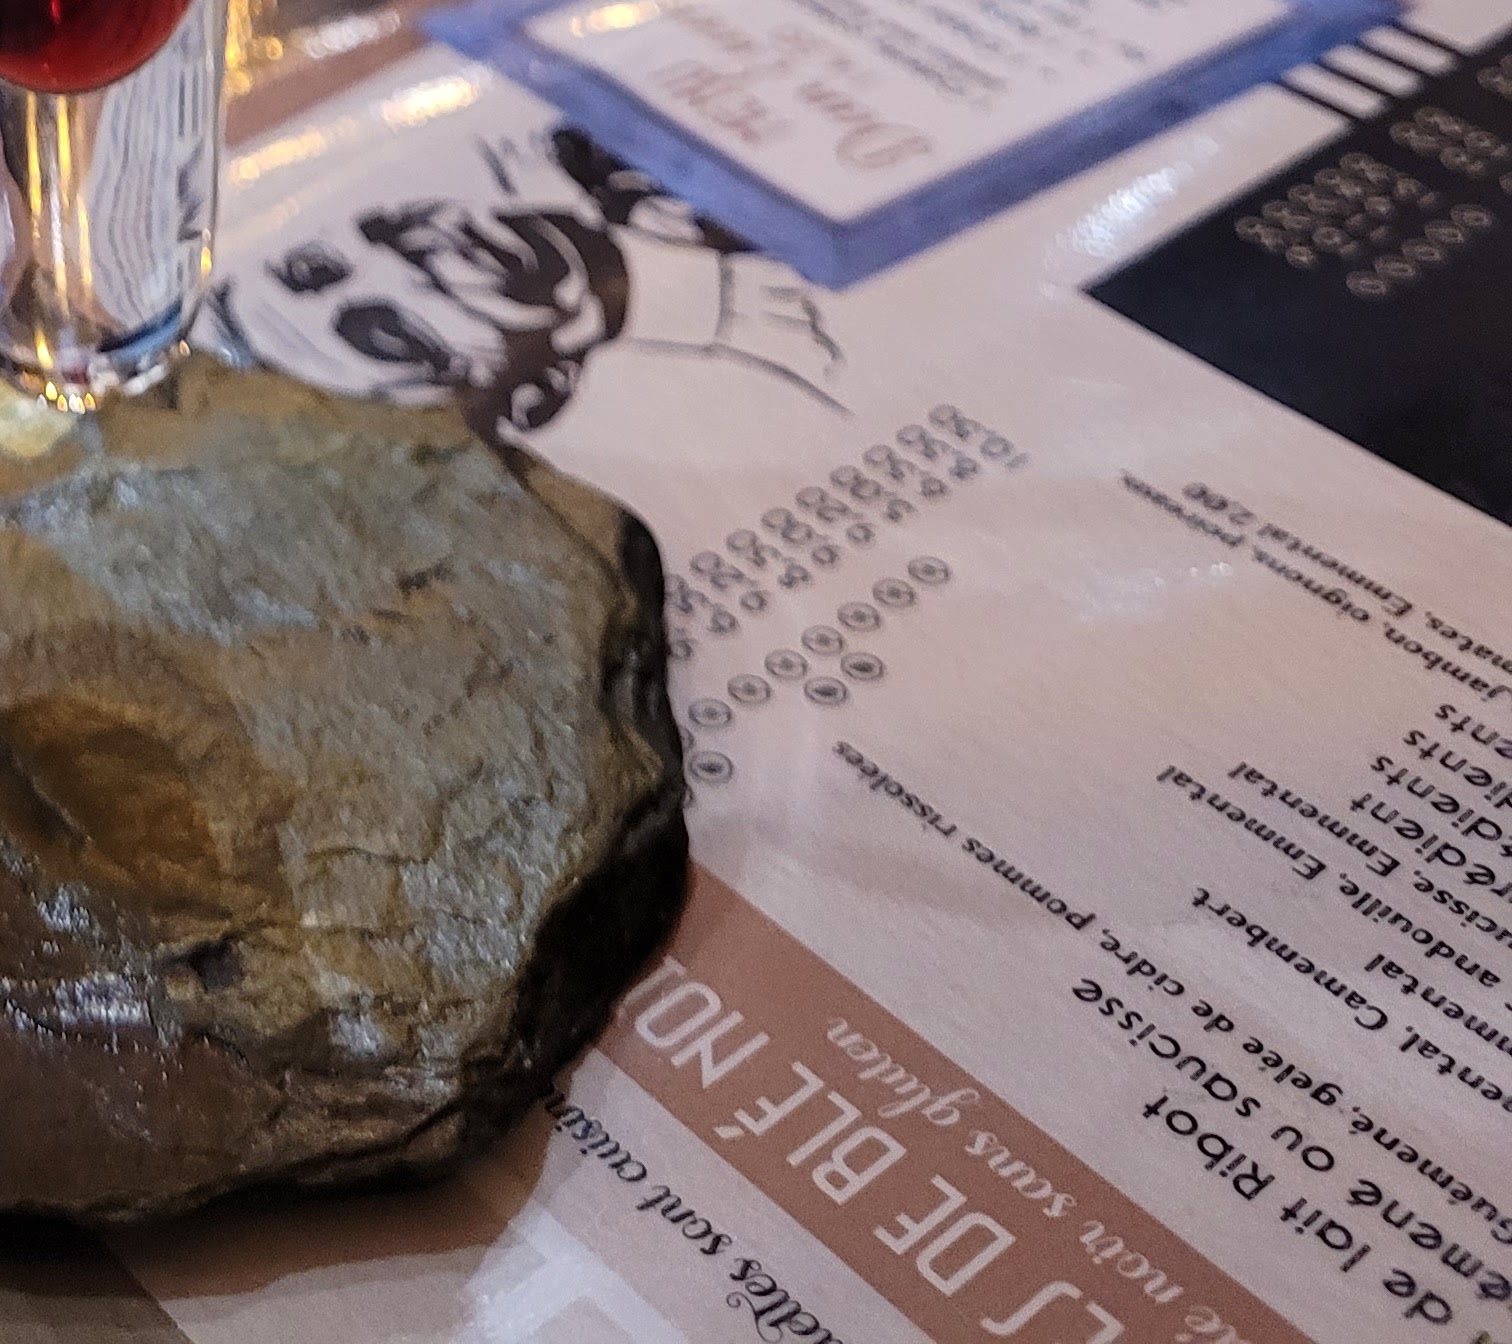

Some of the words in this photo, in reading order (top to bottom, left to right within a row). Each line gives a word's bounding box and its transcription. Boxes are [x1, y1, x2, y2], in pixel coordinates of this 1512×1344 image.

[1253, 522, 1415, 620] Emmental
[1156, 765, 1329, 883] Emmental
[1227, 762, 1402, 879] Emmental
[1349, 792, 1512, 905] rédient
[961, 837, 1098, 933] pommes
[1338, 872, 1502, 989] andouille,
[1098, 927, 1187, 998] cidre,
[1190, 887, 1390, 1033] Camembert
[1071, 977, 1263, 1120] saucisse
[1190, 999, 1236, 1034] de
[825, 1017, 981, 1128] gluten
[1241, 1036, 1345, 1108] gelée
[525, 1080, 649, 1184] cuisin
[712, 1059, 908, 1206] BLÉ
[963, 1129, 1077, 1219] sans
[1141, 1094, 1277, 1203] Ribot
[1269, 1124, 1337, 1174] ou
[635, 1185, 734, 1258] sont
[872, 1173, 1017, 1298] DE
[1078, 1219, 1185, 1305] noir
[1278, 1196, 1372, 1274] lait
[1381, 1267, 1454, 1326] de
